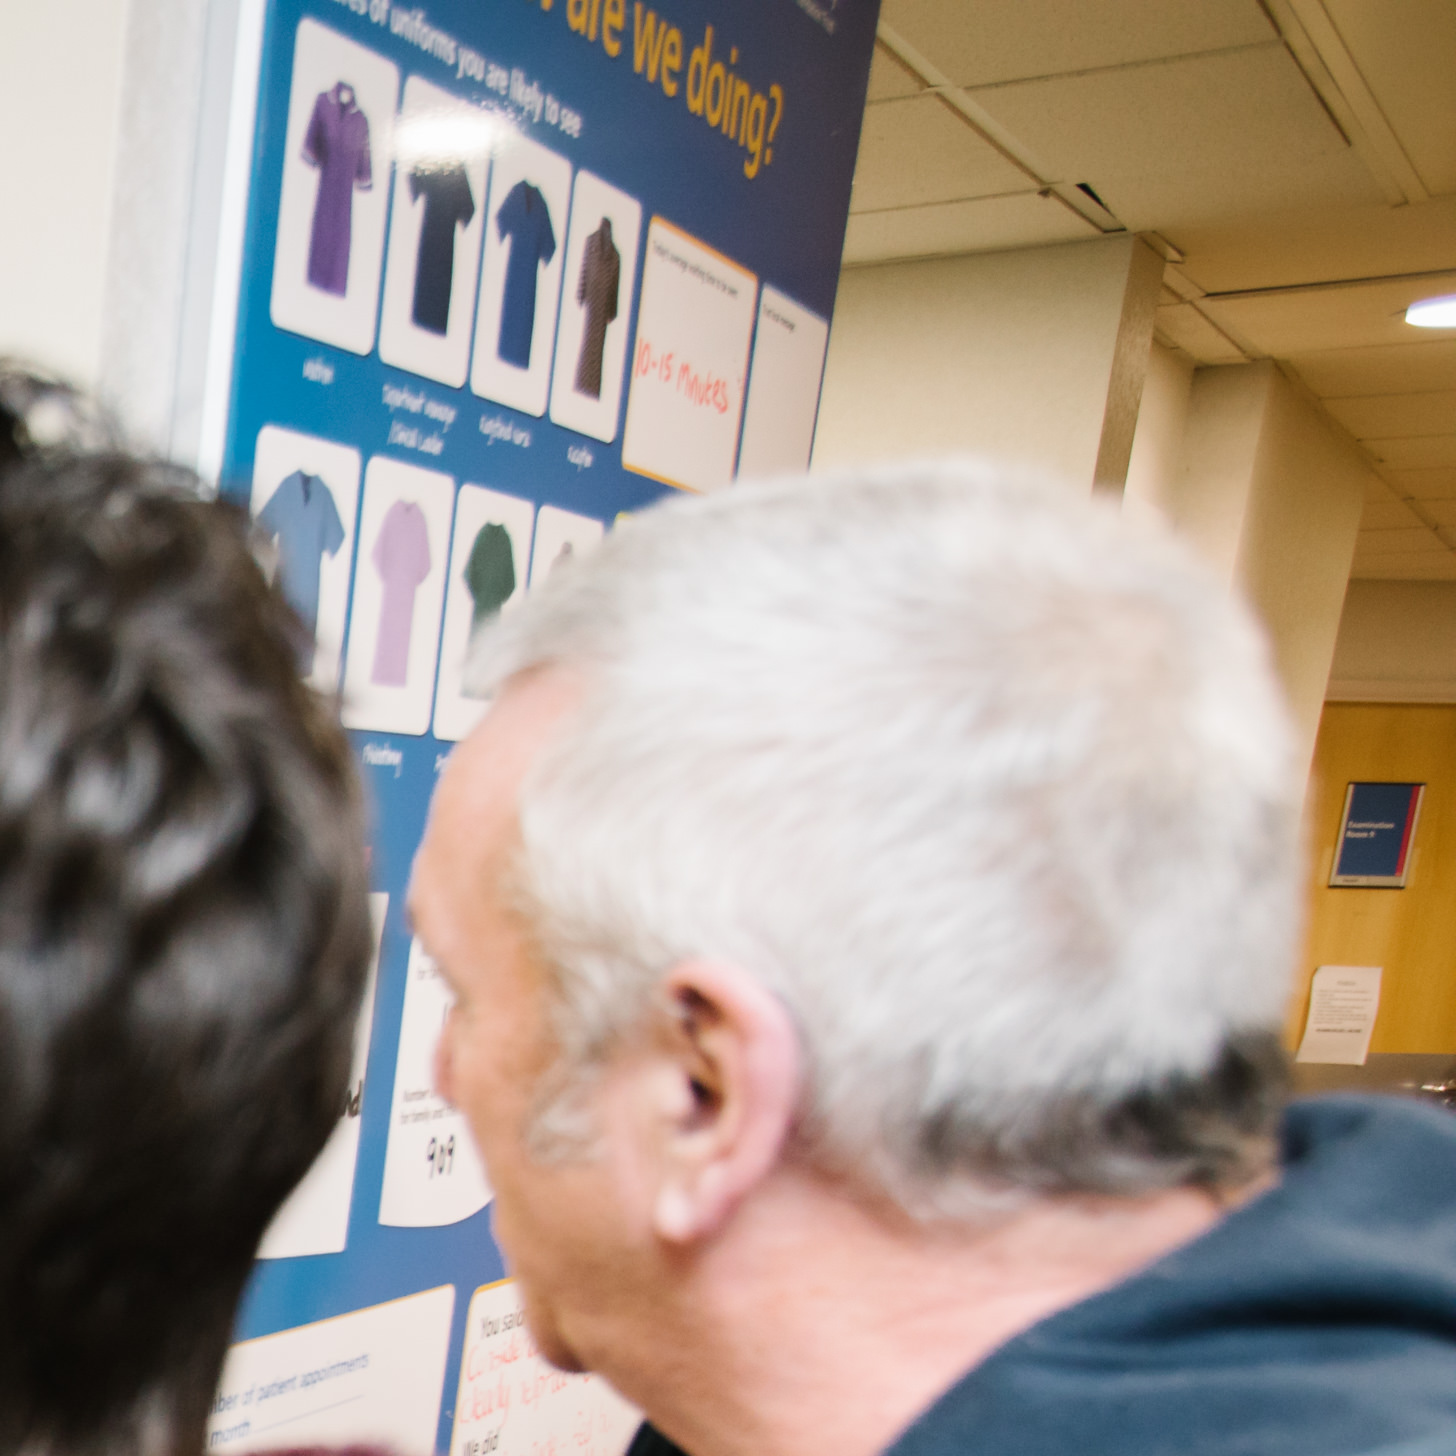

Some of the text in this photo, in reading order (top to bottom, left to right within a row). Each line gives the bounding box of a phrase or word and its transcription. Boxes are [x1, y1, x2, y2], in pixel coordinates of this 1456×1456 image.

[390, 8, 457, 66] uniforms
[456, 46, 486, 80] you
[485, 58, 509, 96] are
[509, 67, 543, 123] likely
[545, 93, 559, 126] to
[559, 105, 583, 139] see
[634, 2, 682, 98] we
[687, 24, 784, 180] doing?
[635, 337, 674, 382] 10-15
[481, 1314, 500, 1340] You
[242, 1384, 255, 1406] of
[257, 1374, 298, 1404] patient
[300, 1353, 370, 1389] appointments
[210, 1417, 251, 1447] month
[481, 1428, 500, 1455] did
